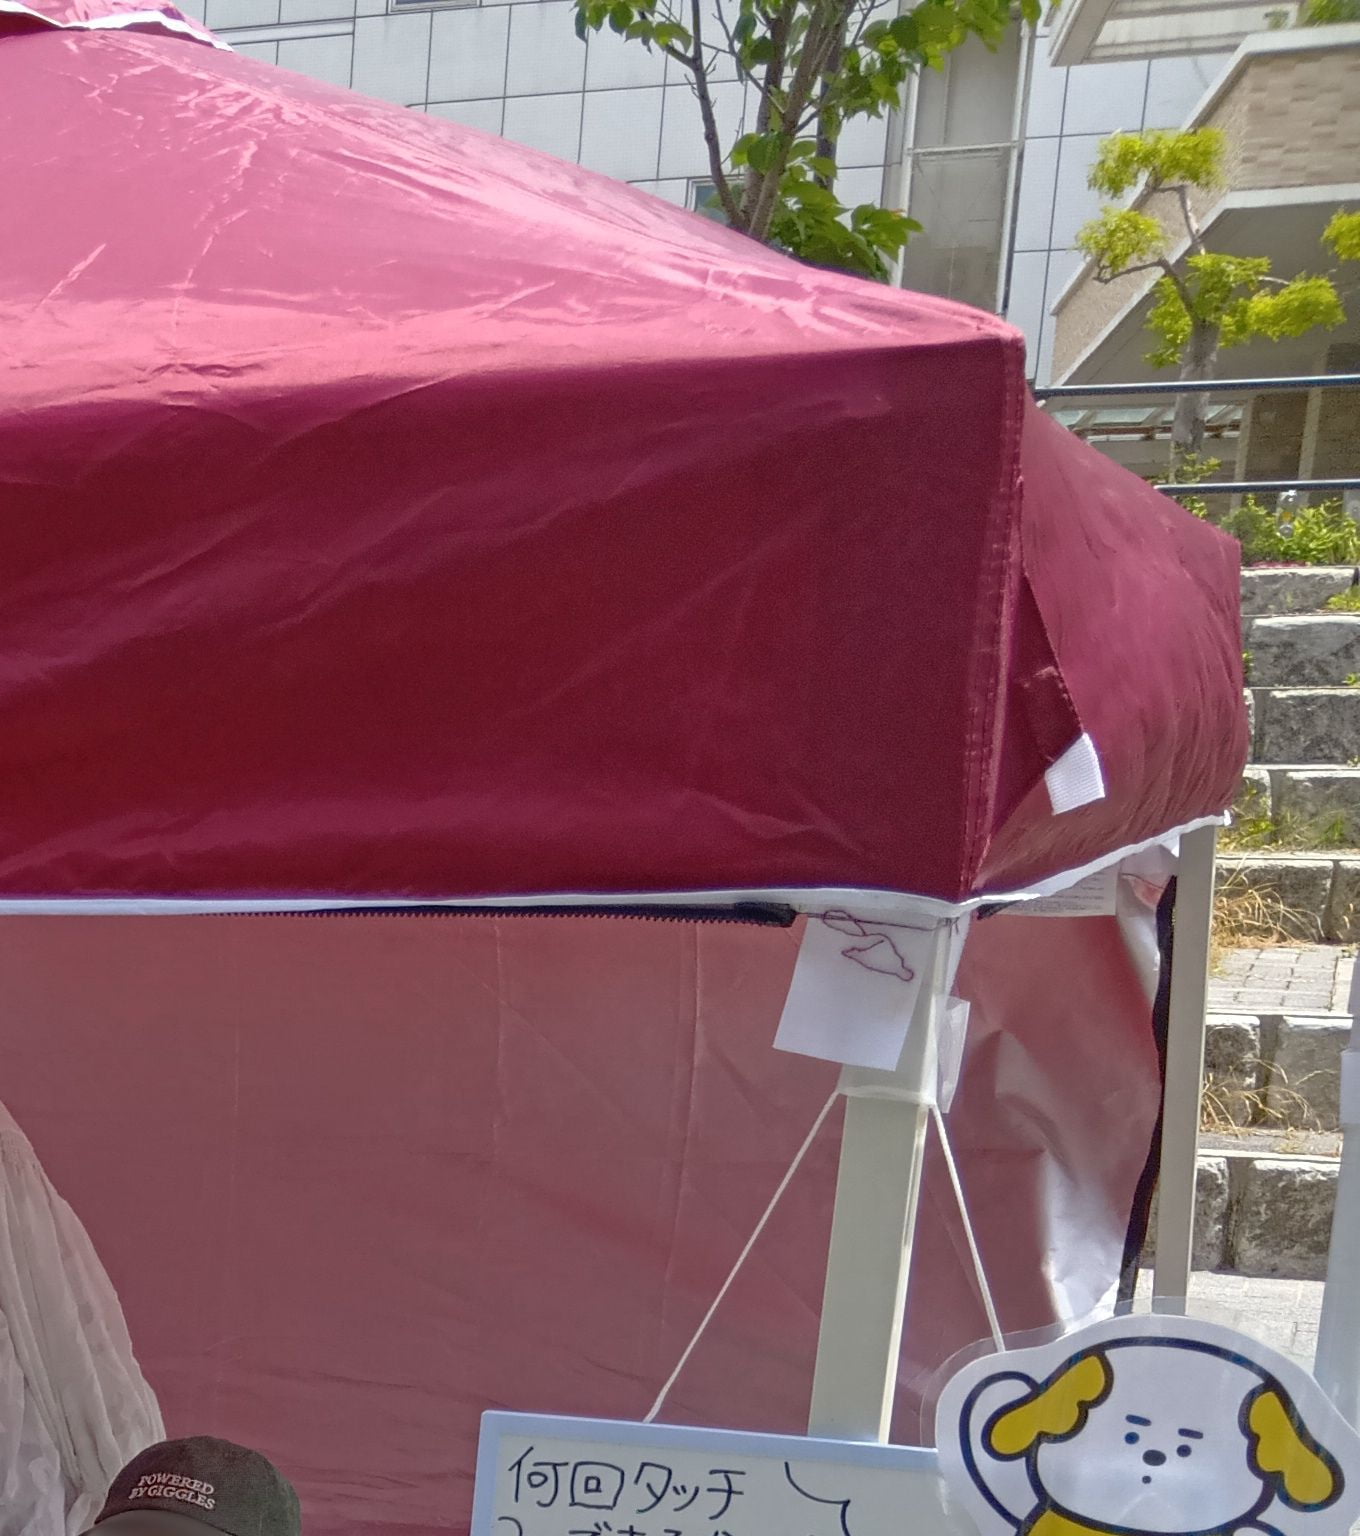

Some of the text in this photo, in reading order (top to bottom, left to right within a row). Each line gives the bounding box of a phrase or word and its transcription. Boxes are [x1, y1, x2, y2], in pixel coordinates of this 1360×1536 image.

[138, 1473, 214, 1495] POWERED
[509, 1447, 744, 1516] 何回タッチ
[129, 1485, 215, 1510] BY GIGGLES
